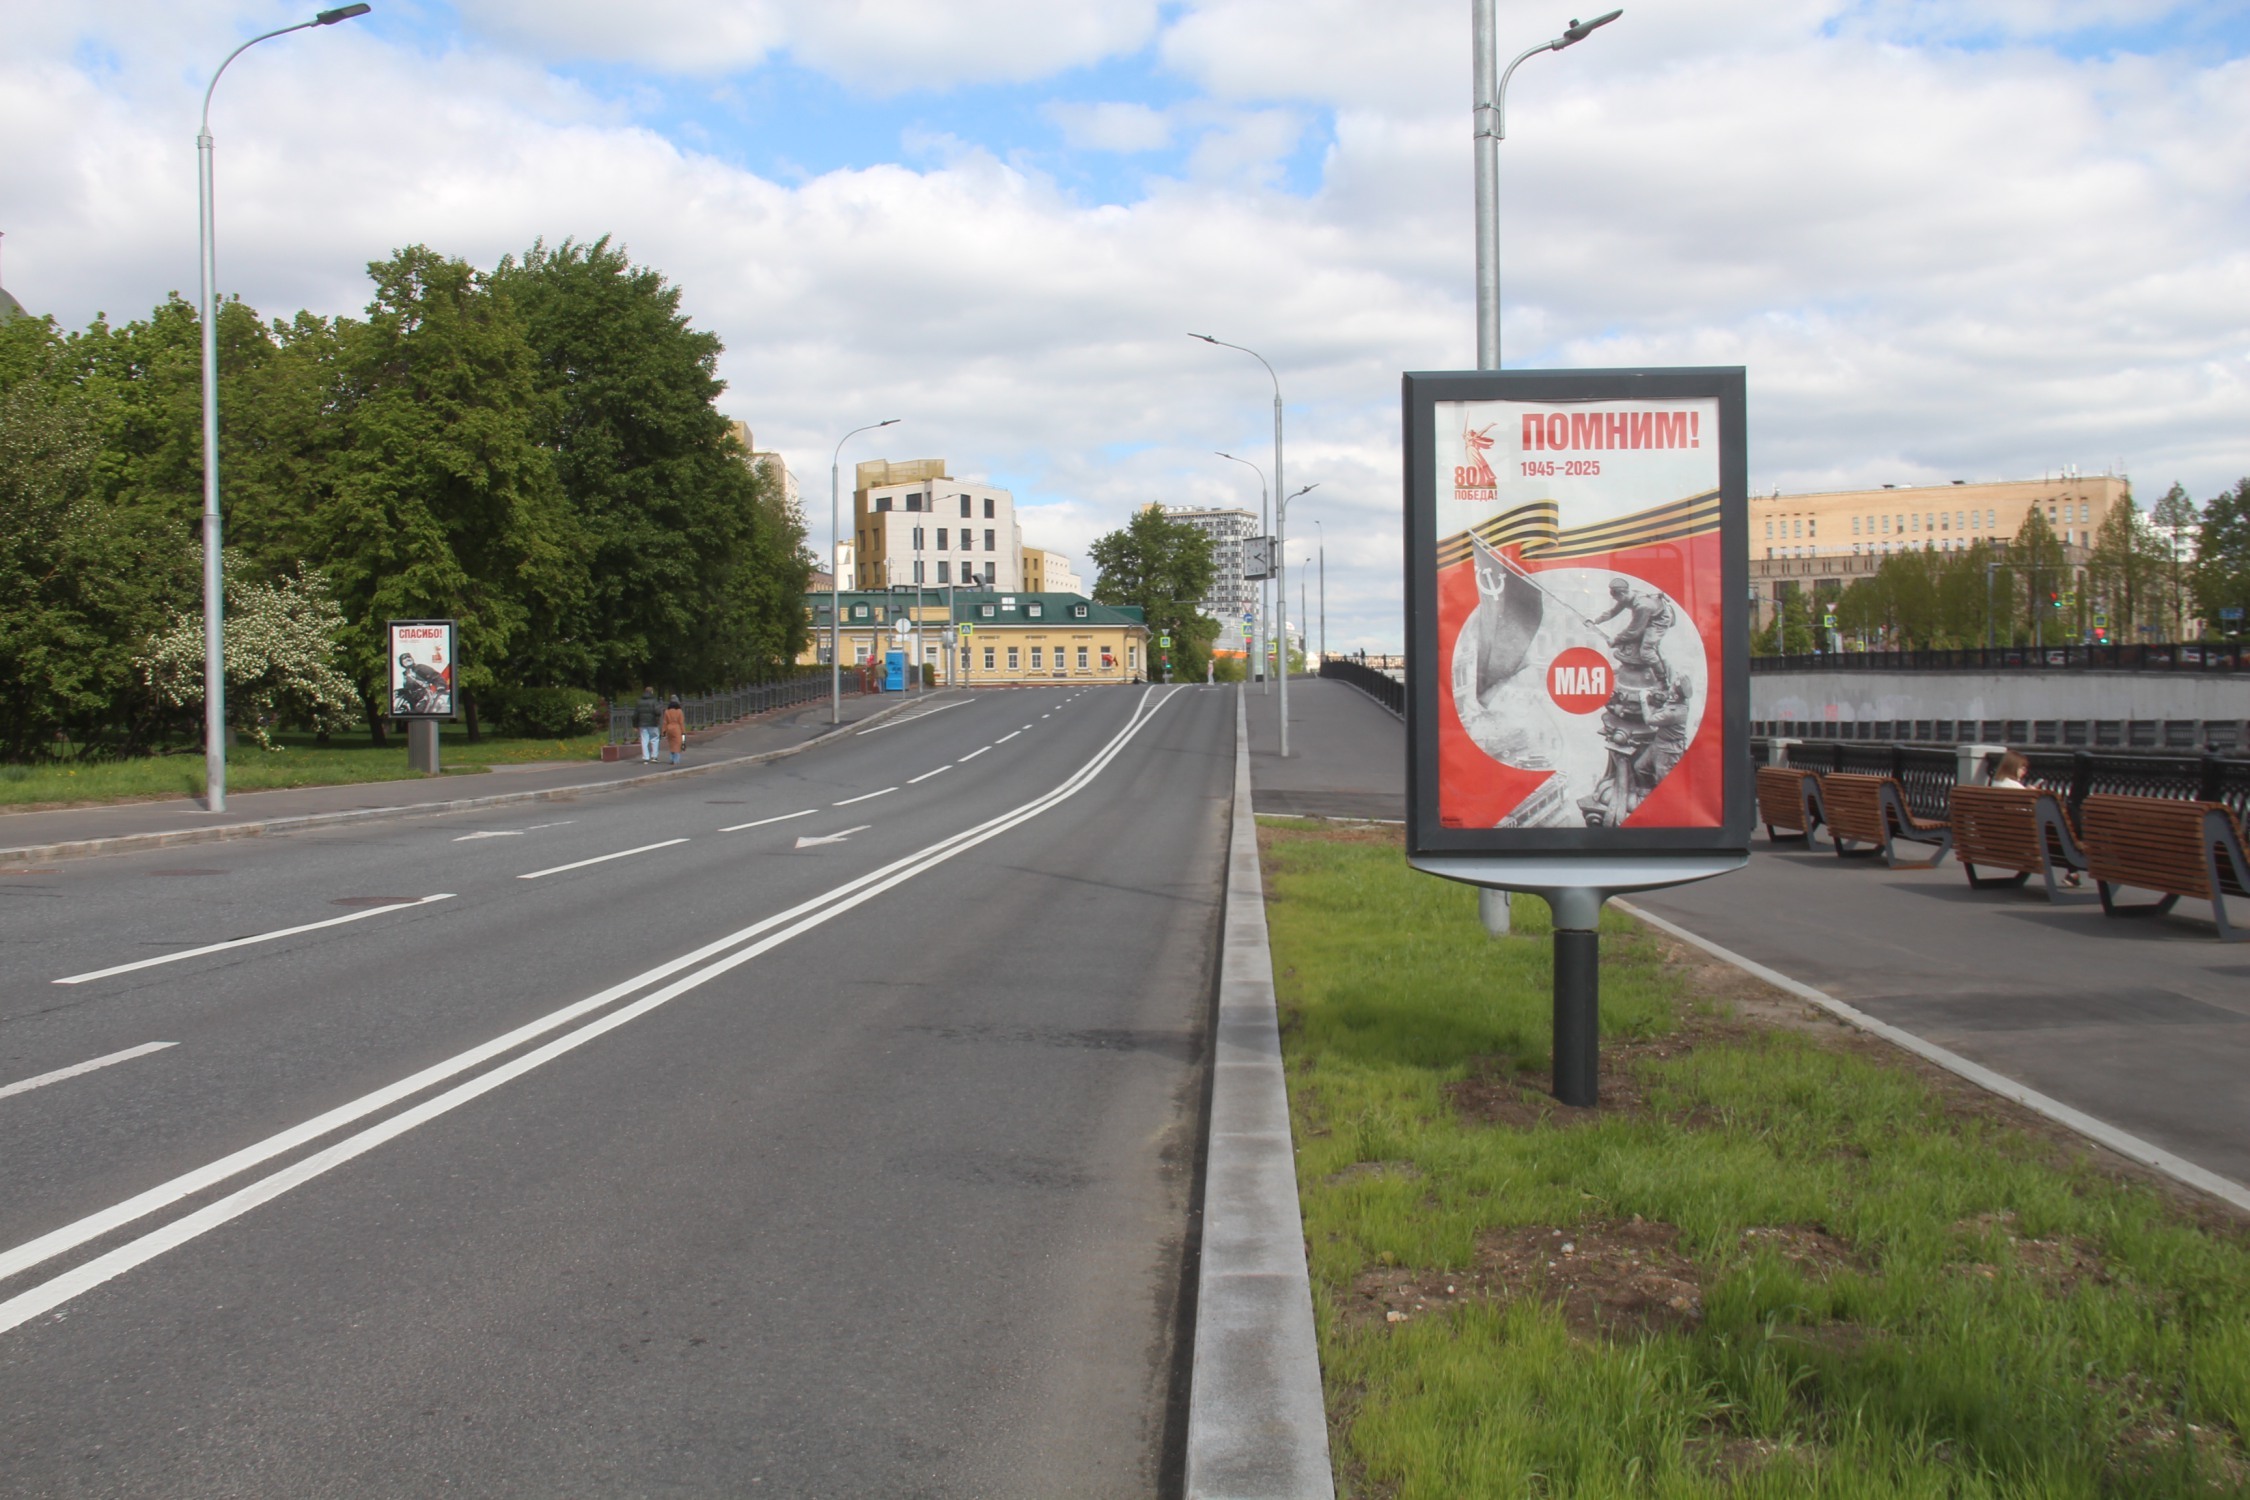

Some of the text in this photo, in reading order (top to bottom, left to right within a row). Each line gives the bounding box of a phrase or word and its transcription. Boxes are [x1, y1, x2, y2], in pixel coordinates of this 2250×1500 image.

[1522, 411, 1700, 451] ПОМНИМ!
[1454, 465, 1479, 486] 80
[1454, 489, 1498, 502] ПОБЕДА!
[398, 628, 443, 639] СПАСИБО!
[1554, 666, 1606, 695] МАЯ
